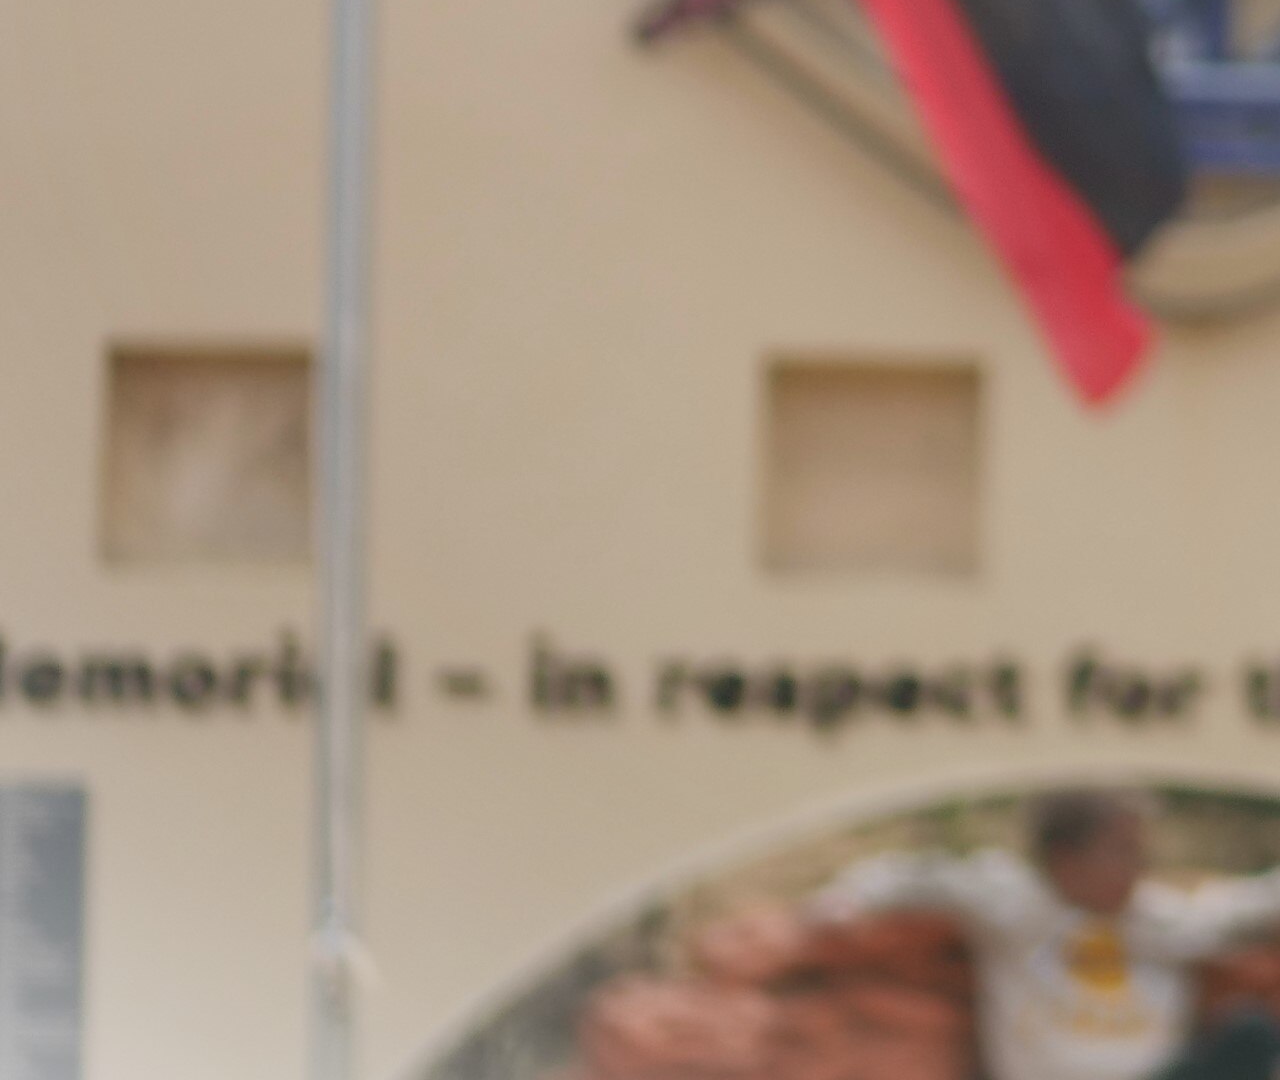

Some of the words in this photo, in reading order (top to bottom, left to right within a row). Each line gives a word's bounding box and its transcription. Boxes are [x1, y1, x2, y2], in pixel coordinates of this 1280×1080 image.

[0, 631, 398, 713] emoril
[529, 630, 614, 713] in
[655, 638, 1022, 742] respect
[1070, 640, 1200, 716] for
